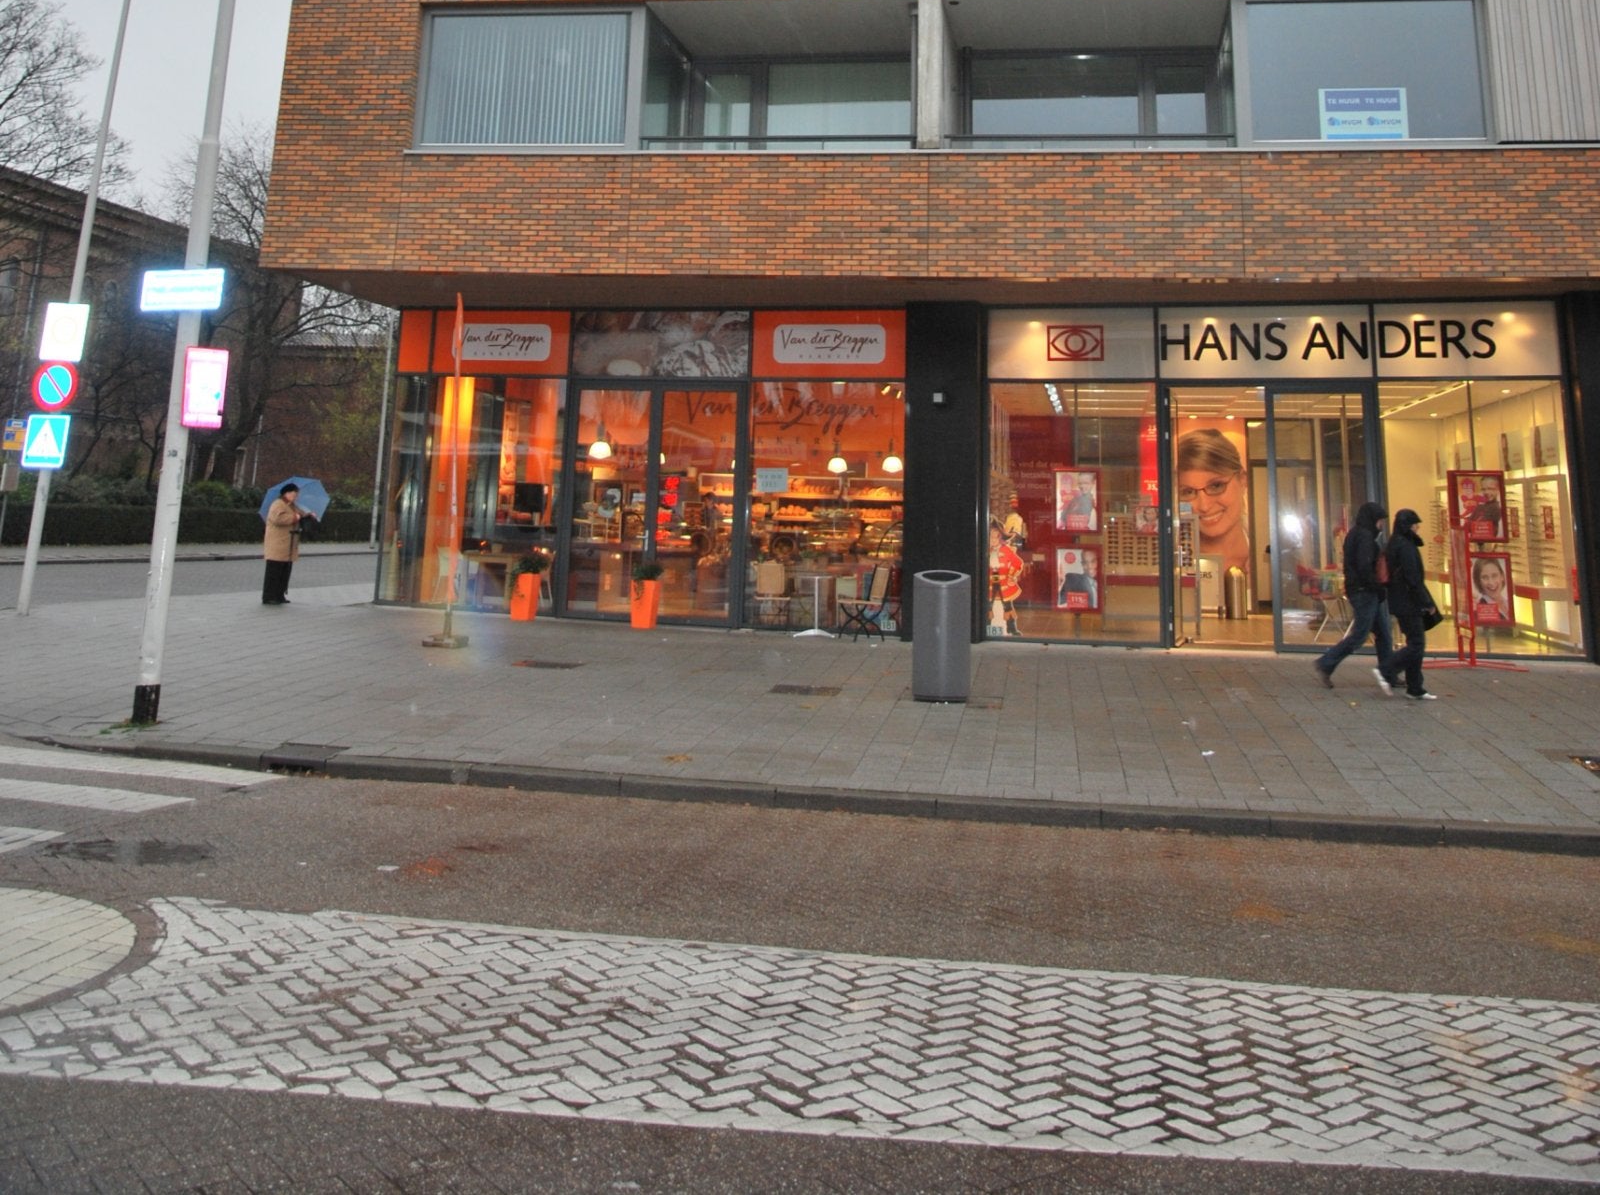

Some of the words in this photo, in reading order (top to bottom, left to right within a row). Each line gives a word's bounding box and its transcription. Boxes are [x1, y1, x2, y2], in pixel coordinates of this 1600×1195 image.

[484, 330, 501, 343] der
[495, 328, 545, 351] Breggen
[781, 329, 807, 349] Van
[810, 332, 830, 344] der
[823, 329, 878, 353] Breggen
[1160, 322, 1287, 361] HANS
[1302, 319, 1496, 360] ANDERS
[780, 388, 878, 435] Breggen
